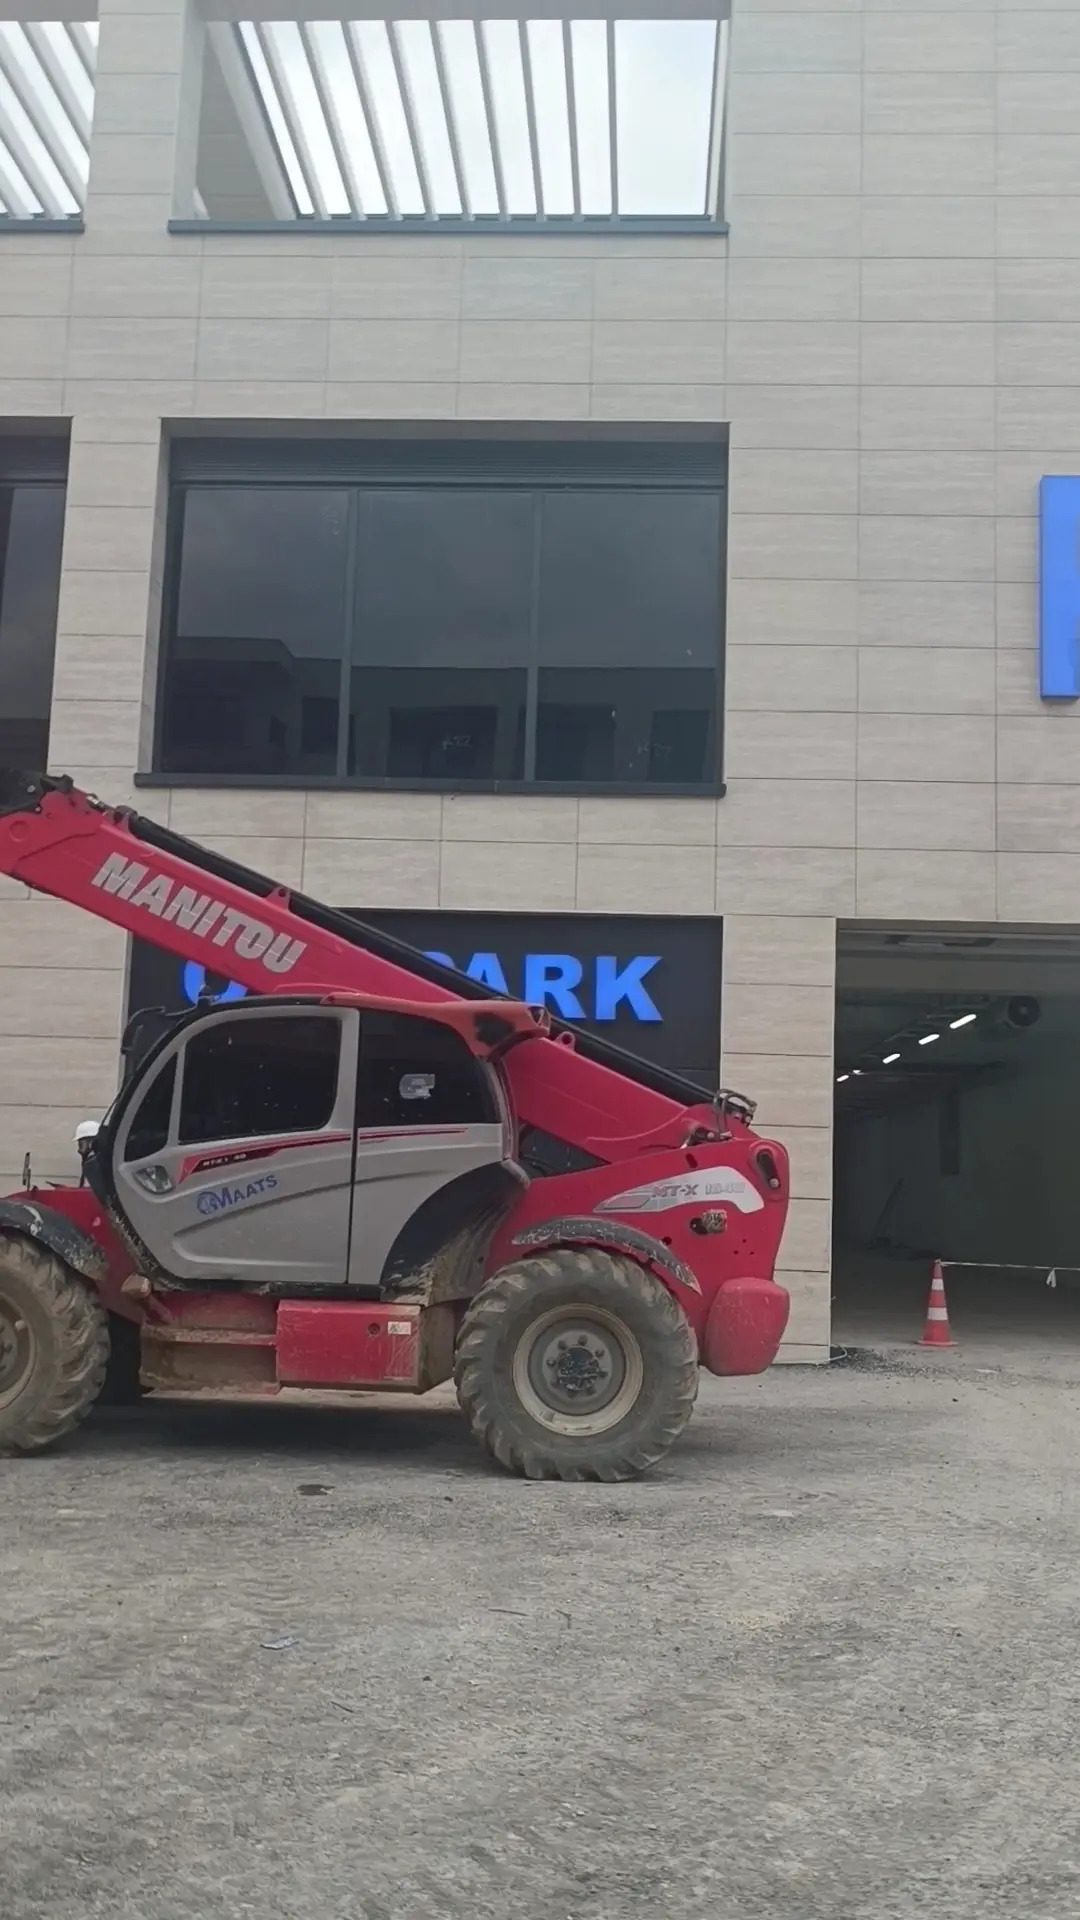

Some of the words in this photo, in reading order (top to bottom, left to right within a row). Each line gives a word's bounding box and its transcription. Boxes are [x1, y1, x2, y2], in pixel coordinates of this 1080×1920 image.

[91, 852, 307, 973] MANITOU
[212, 1174, 278, 1210] MAATS
[651, 1184, 699, 1197] MT-X
